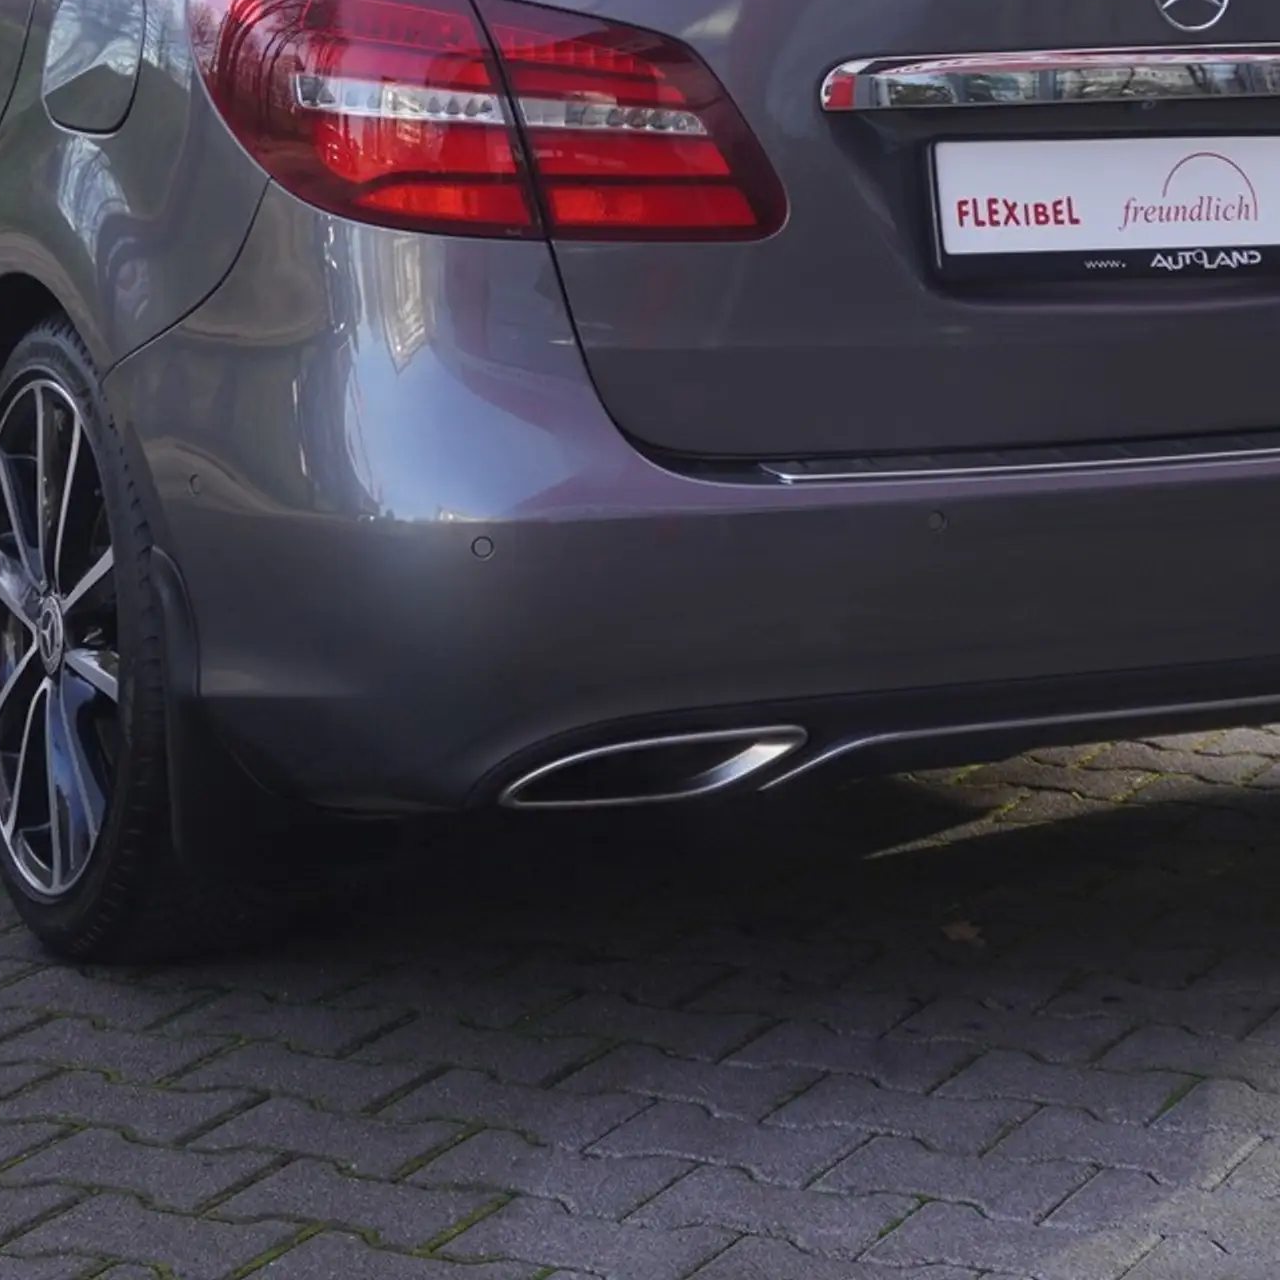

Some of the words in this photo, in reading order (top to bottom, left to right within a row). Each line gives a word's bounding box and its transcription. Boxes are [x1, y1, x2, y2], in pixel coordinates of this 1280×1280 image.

[956, 196, 1081, 228] FLEXIBEL
[1117, 194, 1251, 233] freundlich
[1084, 260, 1127, 269] www.
[1150, 248, 1262, 271] AUTOLAND
